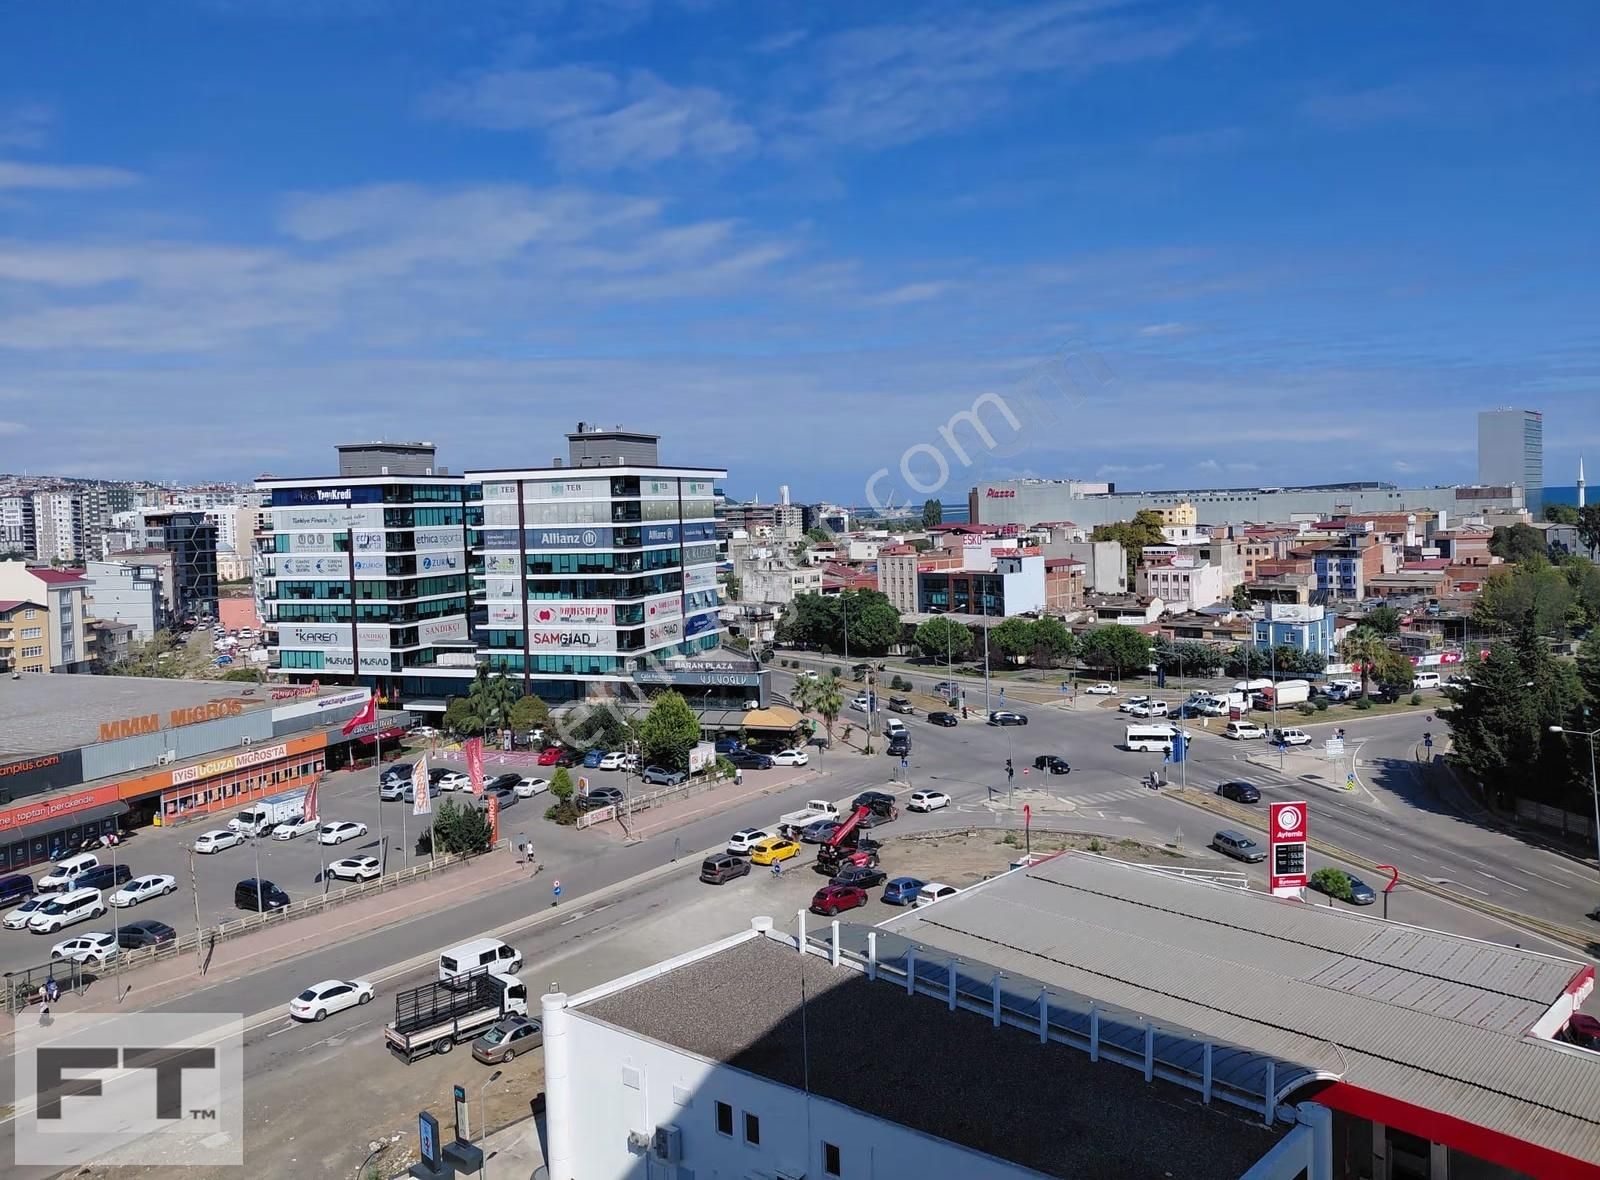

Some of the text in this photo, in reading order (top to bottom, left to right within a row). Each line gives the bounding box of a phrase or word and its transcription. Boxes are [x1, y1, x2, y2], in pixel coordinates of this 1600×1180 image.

[501, 486, 515, 494] TEB
[566, 484, 582, 492] TEB
[416, 533, 438, 545] ethica
[541, 533, 580, 545] Allianz
[963, 534, 982, 546] ESKO
[674, 661, 734, 670] BARAN PLAZA
[100, 714, 159, 741] MMM
[200, 760, 234, 776] UCUZA
[16, 807, 47, 822] toptan
[50, 794, 95, 813] perakende
